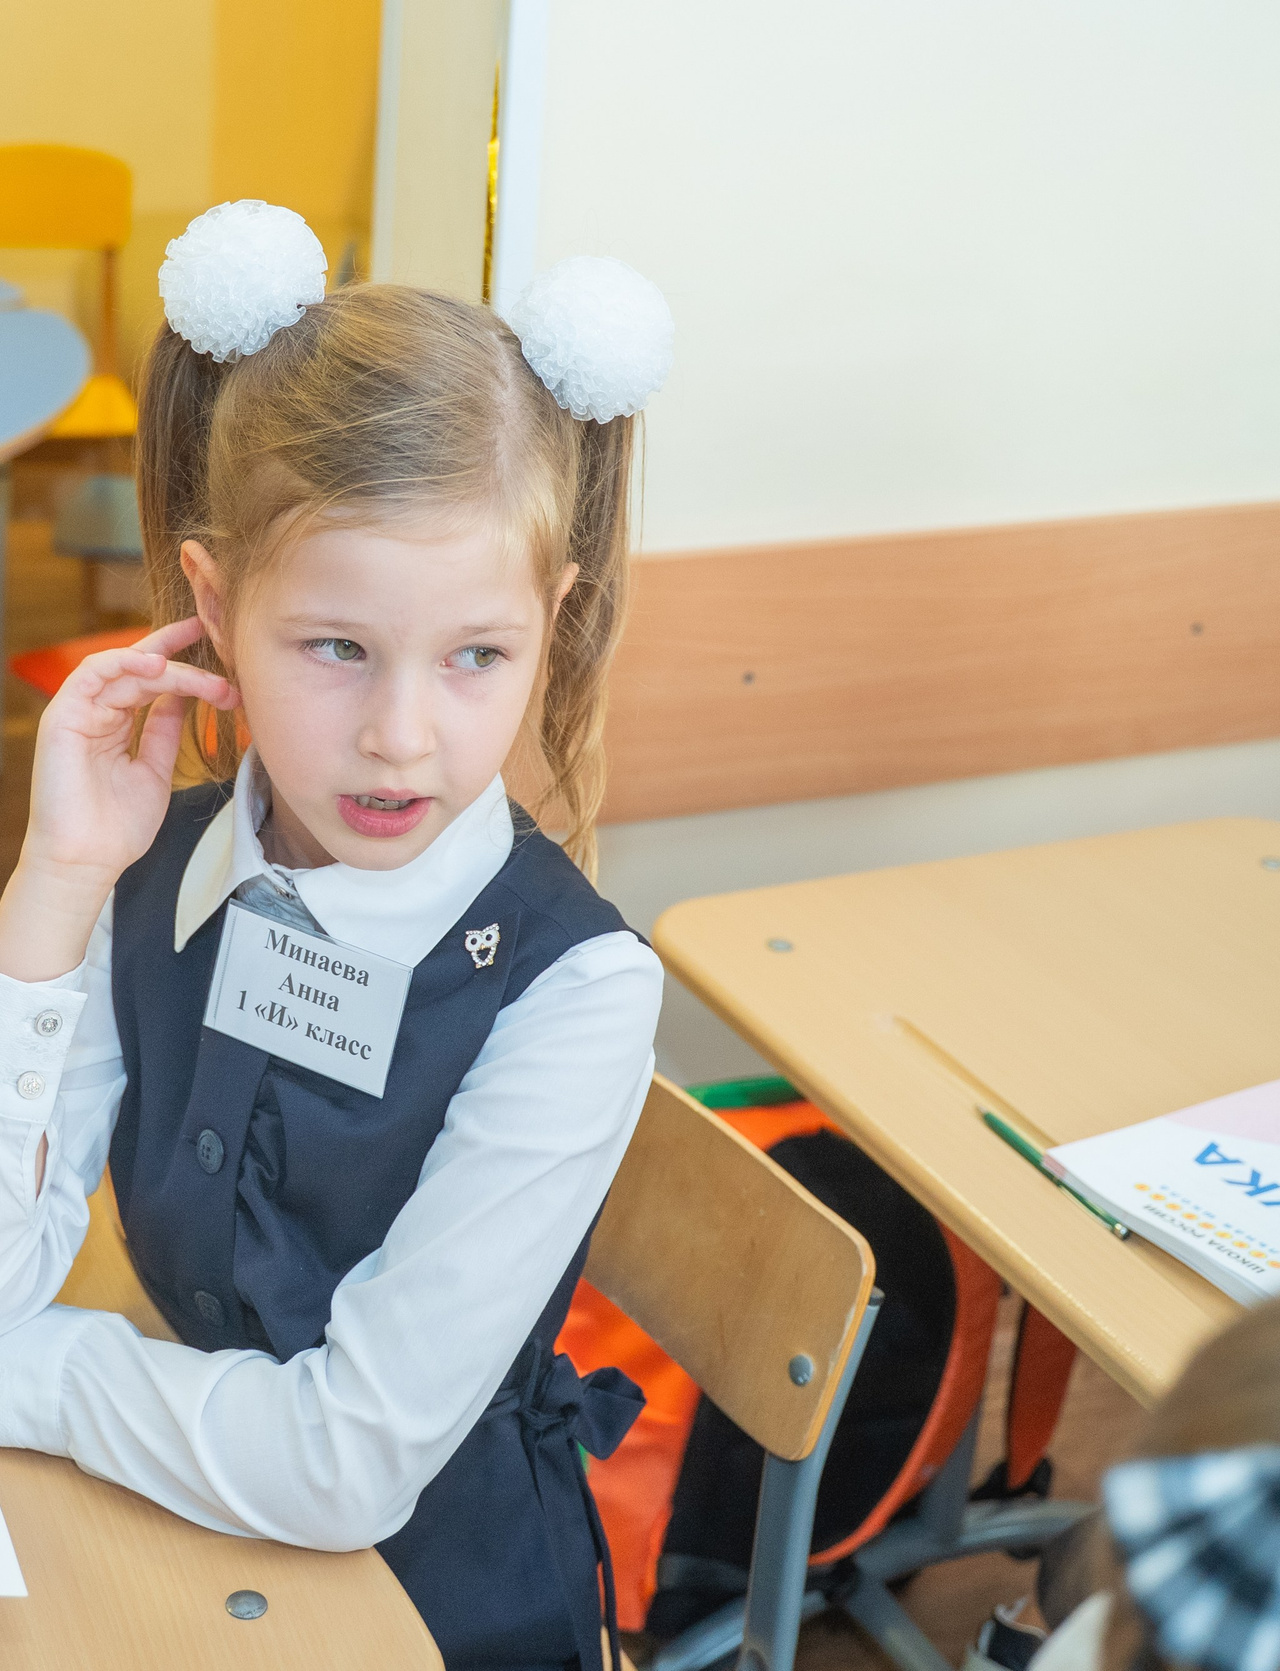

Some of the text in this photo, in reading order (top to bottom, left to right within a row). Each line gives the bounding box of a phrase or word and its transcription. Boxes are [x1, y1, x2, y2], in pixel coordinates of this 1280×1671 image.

[264, 928, 370, 987] Минаева
[278, 972, 340, 1012] Анна
[236, 990, 372, 1060] 1 «И» класс
